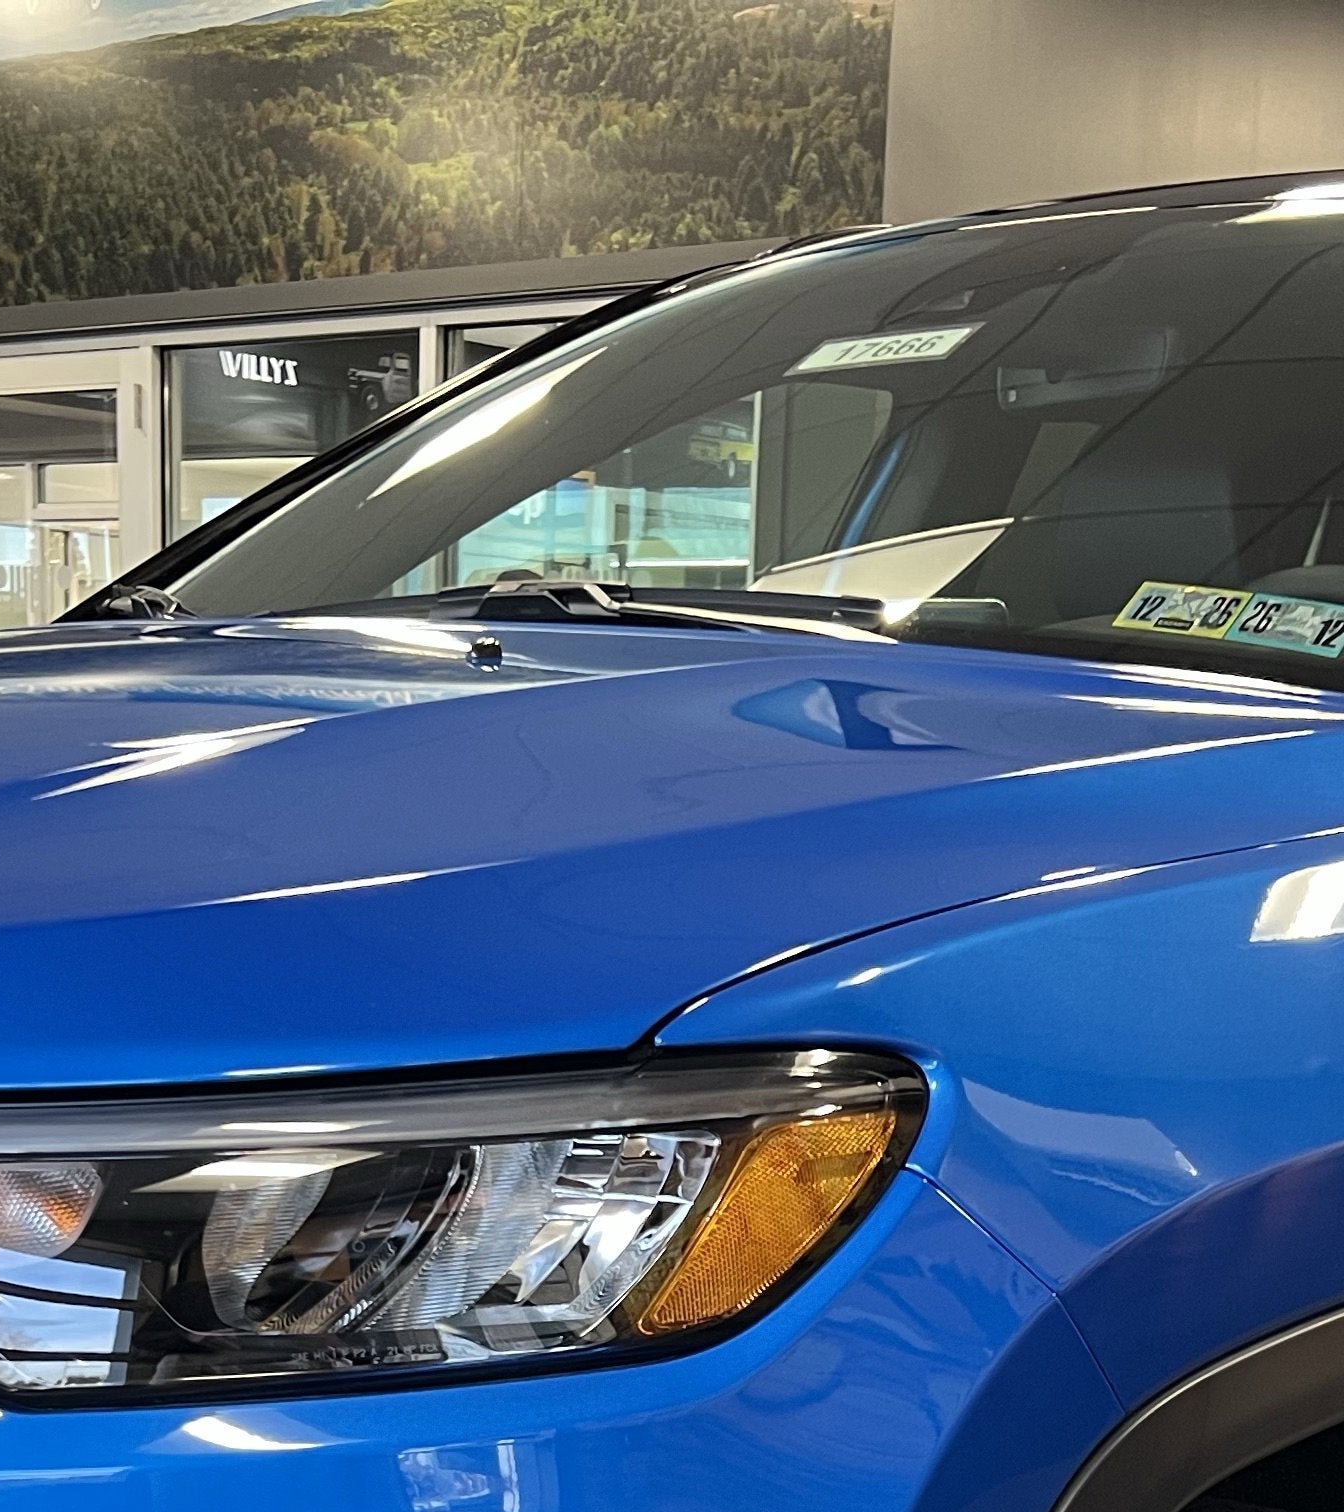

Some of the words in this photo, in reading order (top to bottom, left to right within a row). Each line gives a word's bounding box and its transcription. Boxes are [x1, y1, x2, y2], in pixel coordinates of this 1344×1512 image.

[834, 335, 944, 363] 17666
[219, 350, 298, 386] WILLYS
[1130, 595, 1166, 621] 12
[1199, 596, 1242, 630] 26
[1238, 601, 1281, 634] 26
